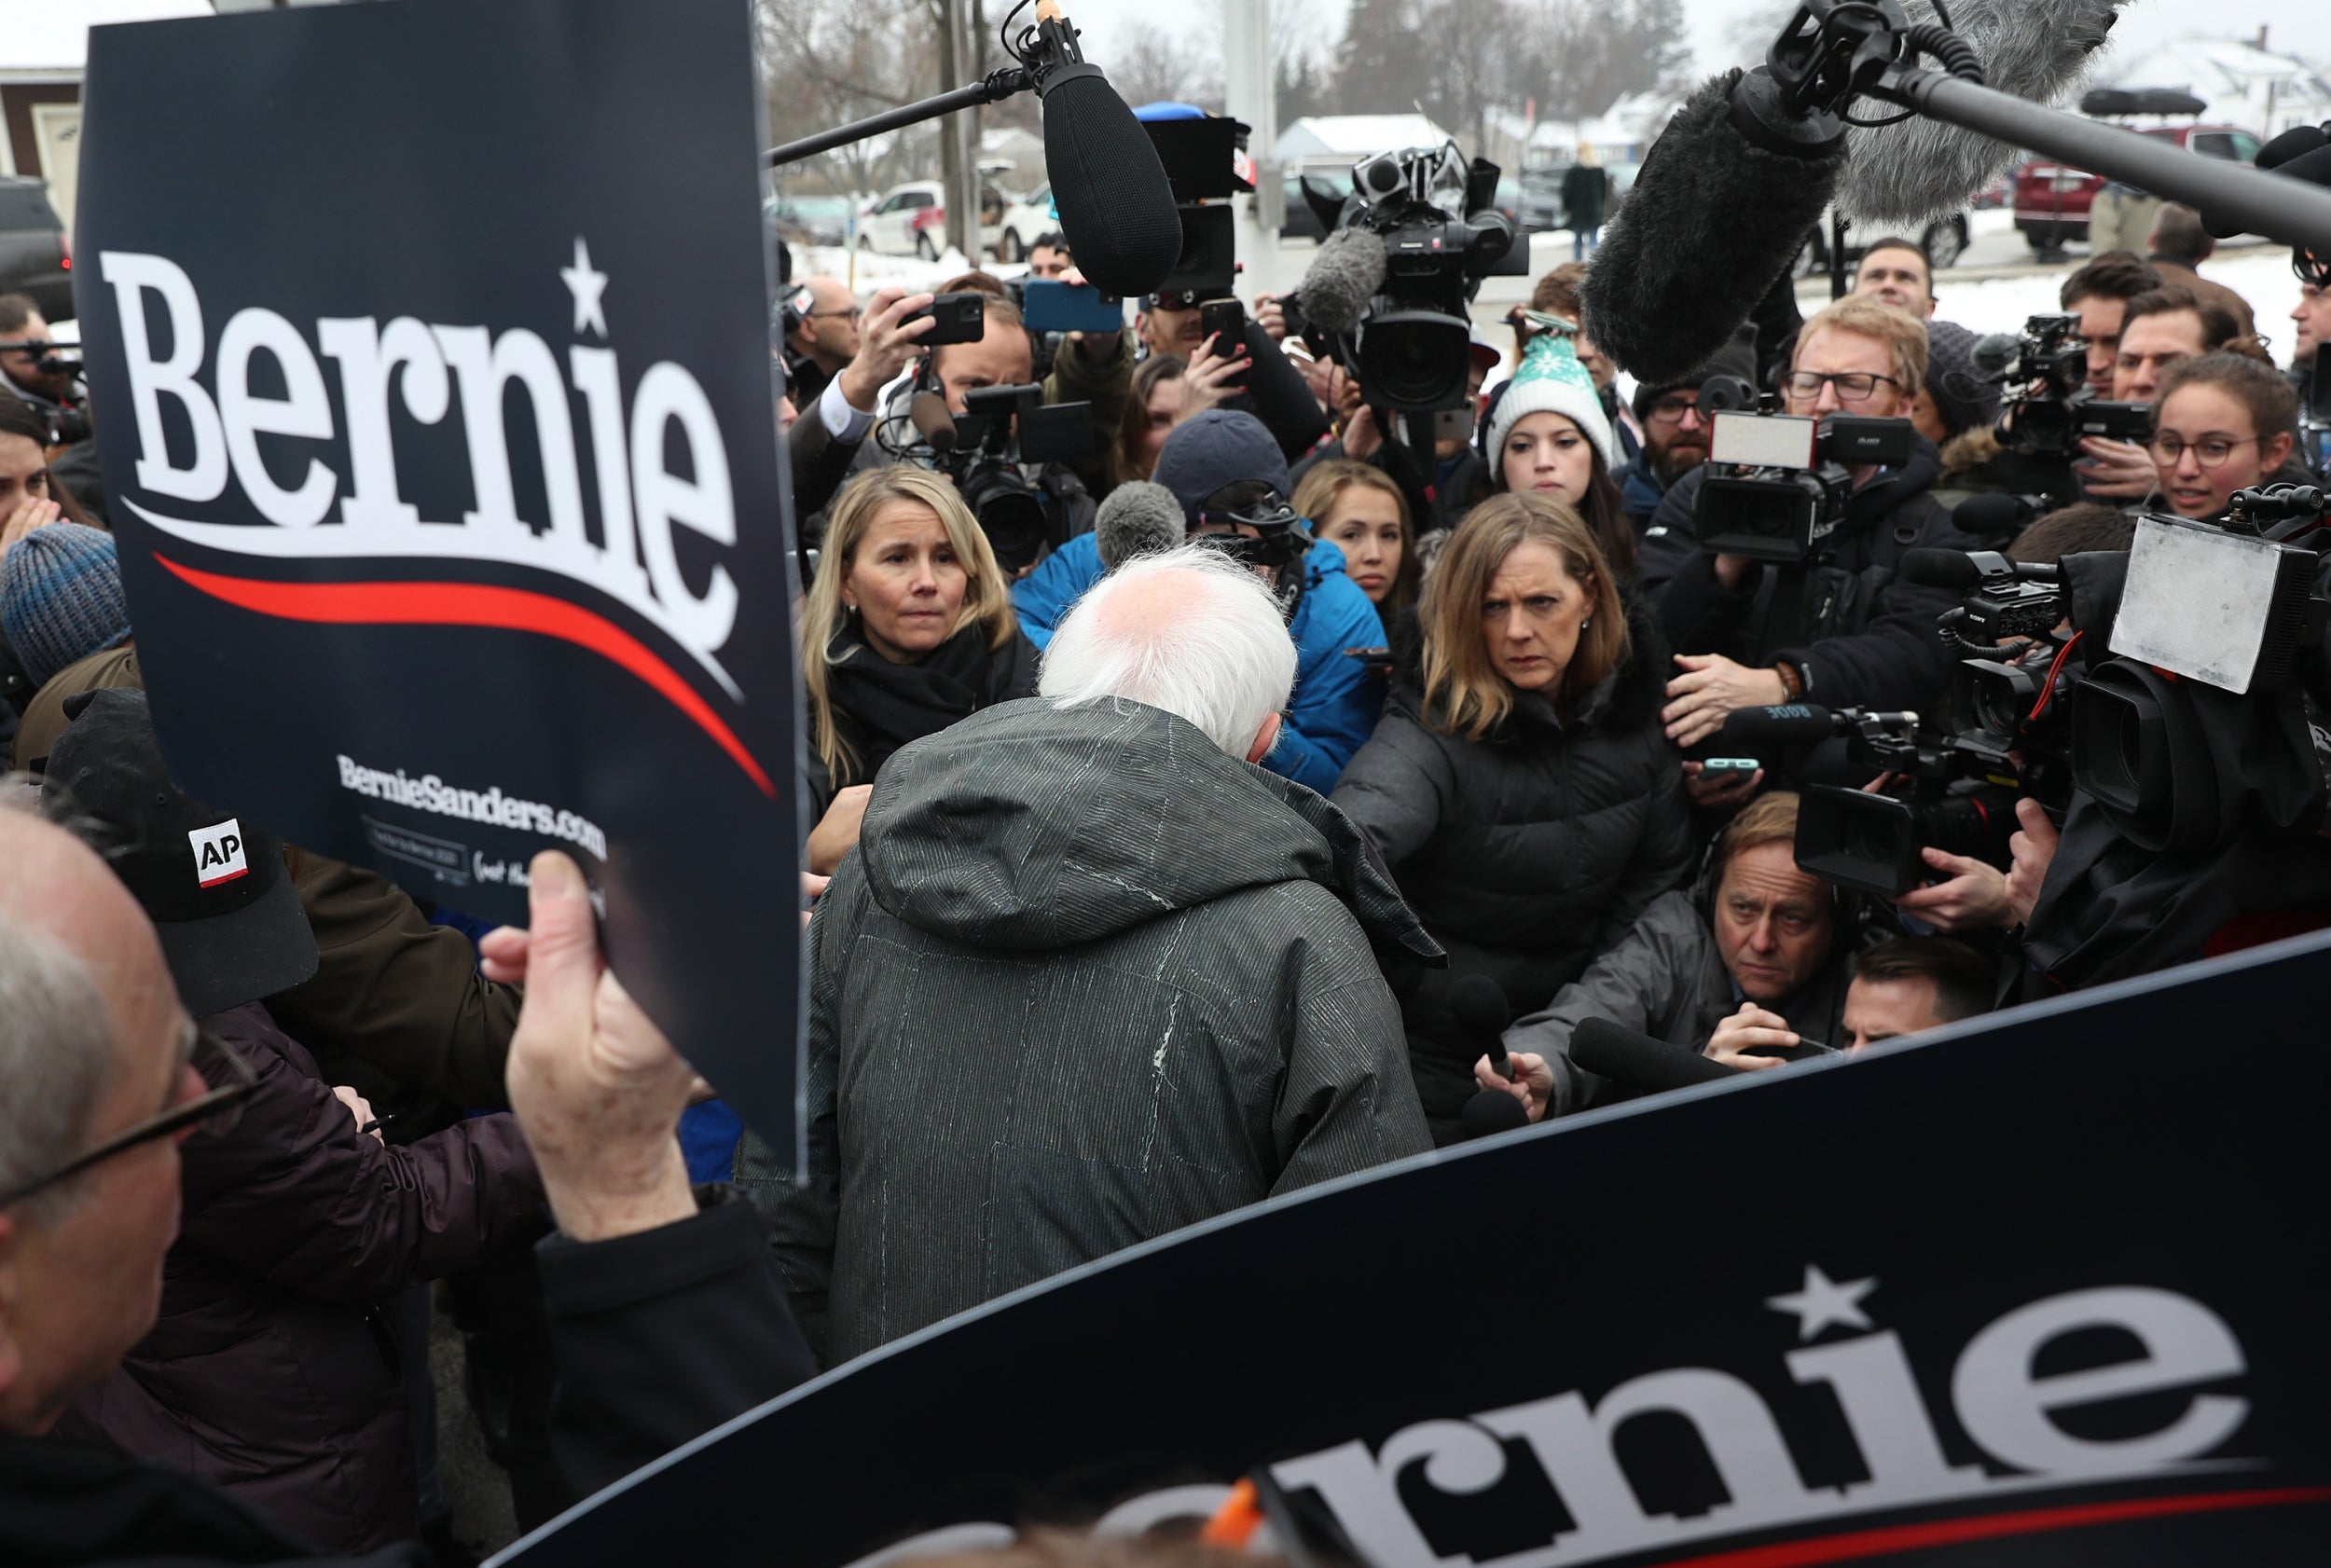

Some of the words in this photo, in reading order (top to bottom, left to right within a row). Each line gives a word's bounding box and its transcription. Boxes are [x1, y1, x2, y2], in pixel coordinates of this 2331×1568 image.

[100, 235, 738, 654] Bernie
[201, 834, 240, 871] AP
[337, 753, 608, 862] BernieSanders.com
[841, 1265, 2252, 1568] rnie
